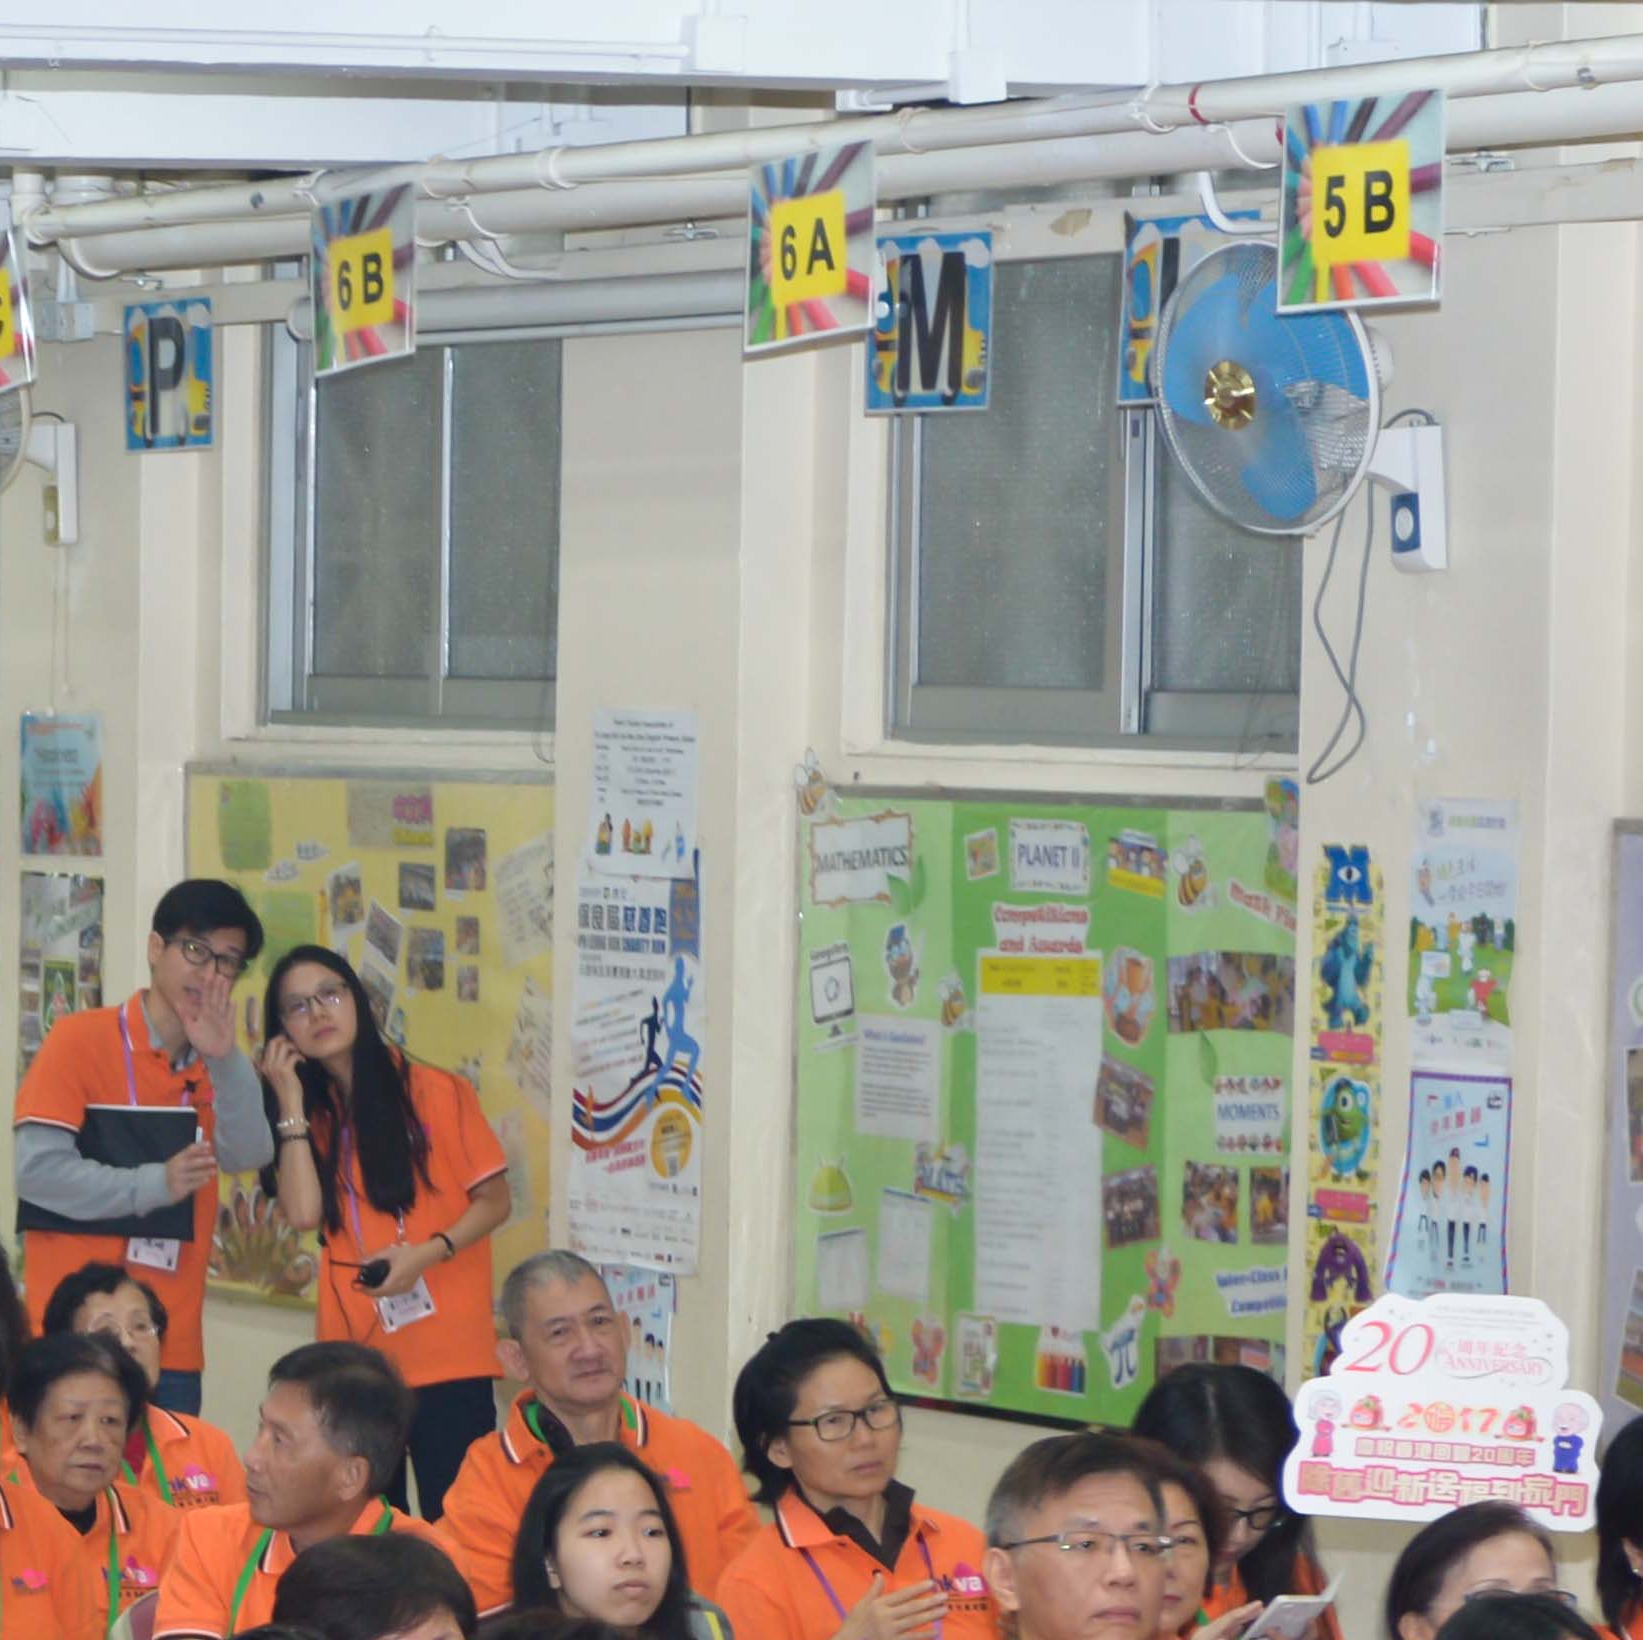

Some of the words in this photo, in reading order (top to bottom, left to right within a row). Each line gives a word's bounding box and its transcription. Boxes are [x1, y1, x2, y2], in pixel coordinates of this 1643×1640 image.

[898, 253, 966, 394] M
[146, 316, 186, 436] P
[814, 844, 908, 874] MATHEMATICS
[1017, 843, 1069, 868] PLANET
[1217, 1103, 1281, 1121] MOMENTS
[1345, 1320, 1435, 1375] 20
[1443, 1357, 1544, 1376] ANNIVERSARY
